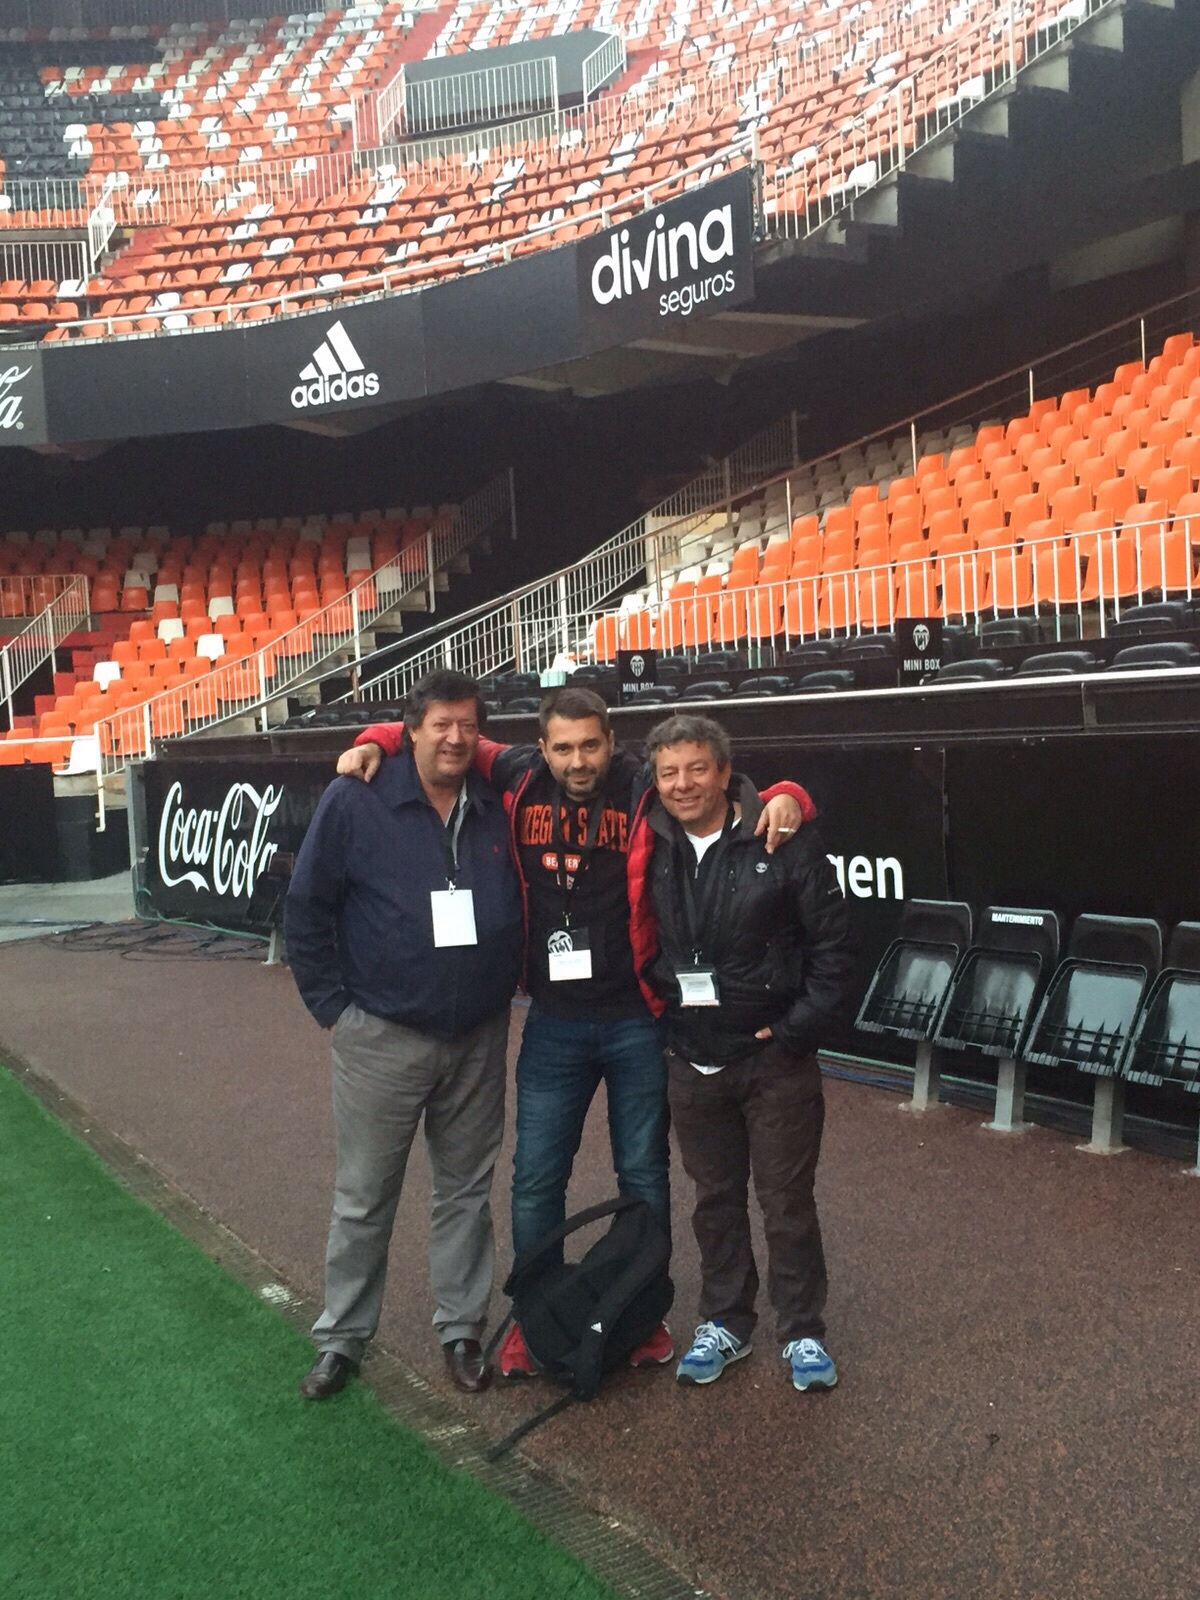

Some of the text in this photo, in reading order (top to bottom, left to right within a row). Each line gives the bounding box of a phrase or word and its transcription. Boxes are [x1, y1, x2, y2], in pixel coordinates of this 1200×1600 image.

[591, 204, 734, 305] divina
[659, 269, 736, 316] seguros
[290, 371, 380, 409] adidas
[903, 658, 941, 671] MINI BOX
[622, 682, 640, 693] MINI
